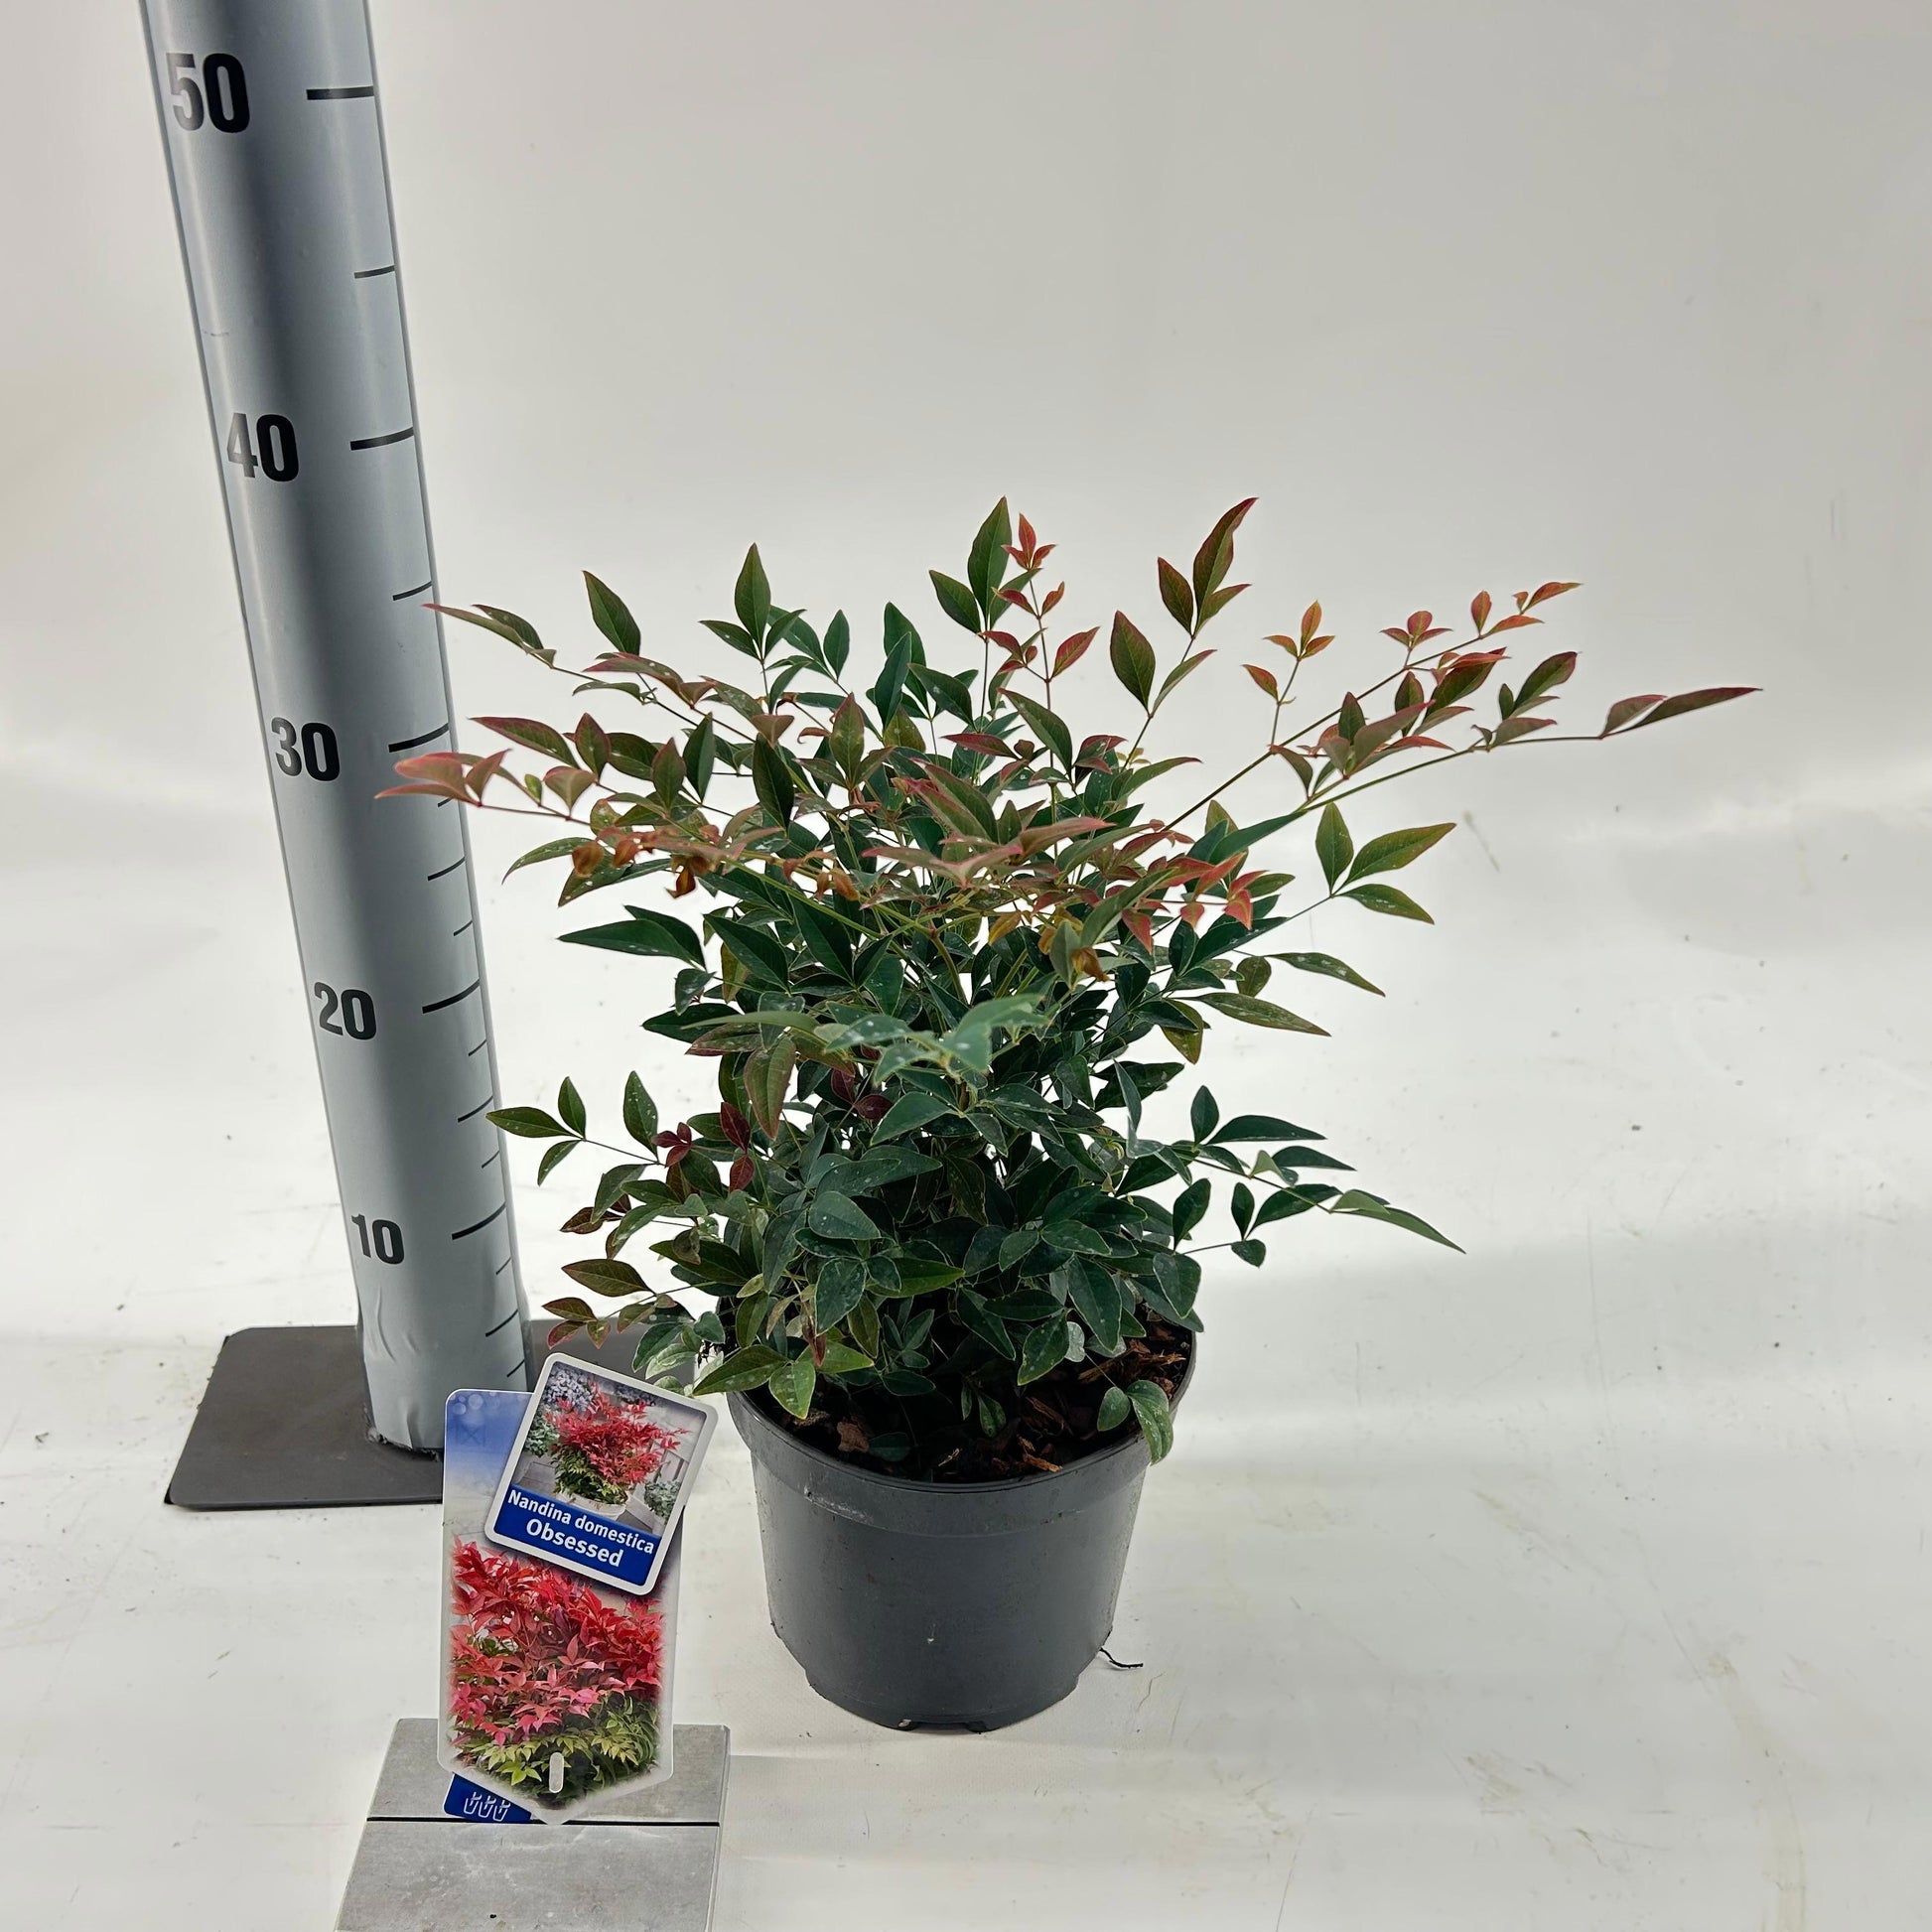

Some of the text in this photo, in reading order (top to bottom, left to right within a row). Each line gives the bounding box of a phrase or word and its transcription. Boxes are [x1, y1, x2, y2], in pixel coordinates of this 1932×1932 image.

[166, 53, 250, 134] 50
[226, 412, 300, 483] 40
[270, 716, 341, 782] 30
[314, 981, 377, 1041] 20
[350, 1213, 405, 1265] 10
[507, 1489, 655, 1555] Nandina domestica
[525, 1517, 624, 1568] Obsessed
